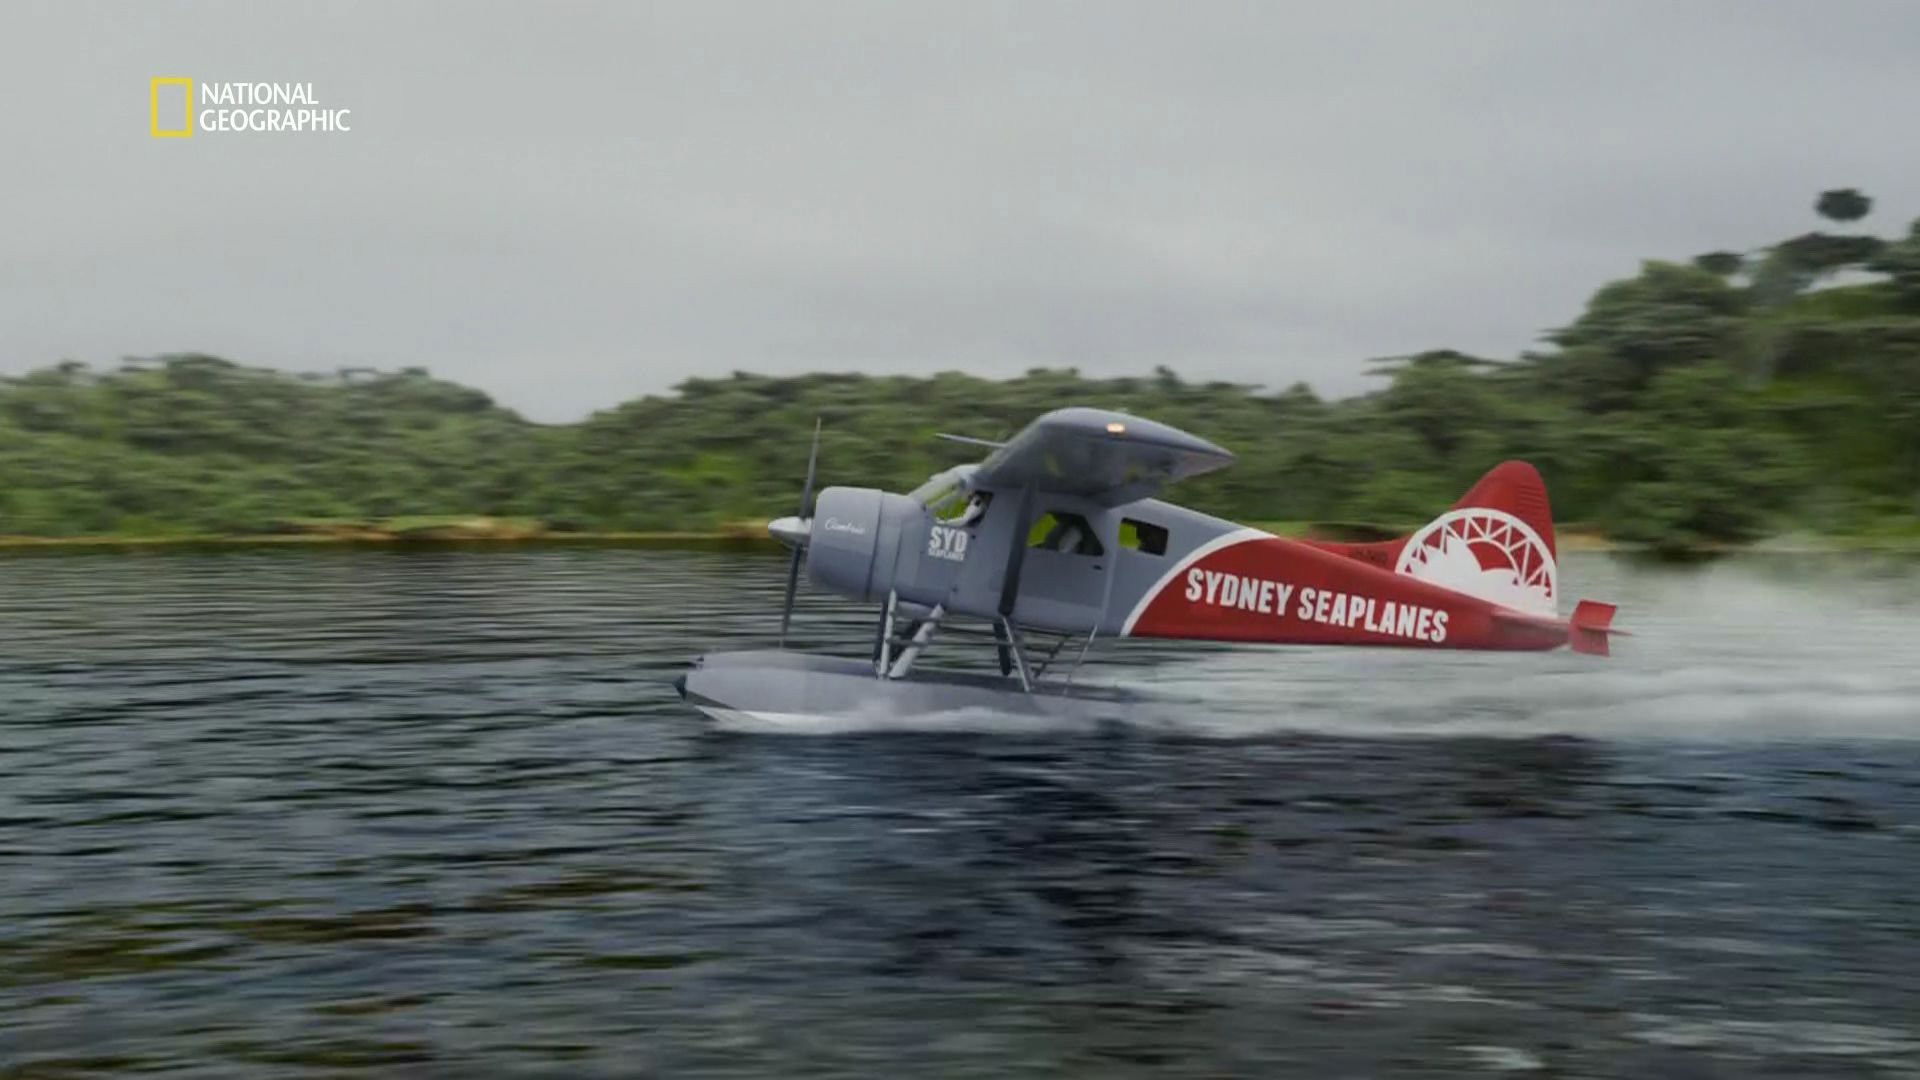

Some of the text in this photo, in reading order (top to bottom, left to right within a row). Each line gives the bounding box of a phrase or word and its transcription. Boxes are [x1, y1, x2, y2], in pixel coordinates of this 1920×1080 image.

[929, 526, 968, 552] SYD
[1185, 567, 1449, 643] SYDNEY SEAPLANES
